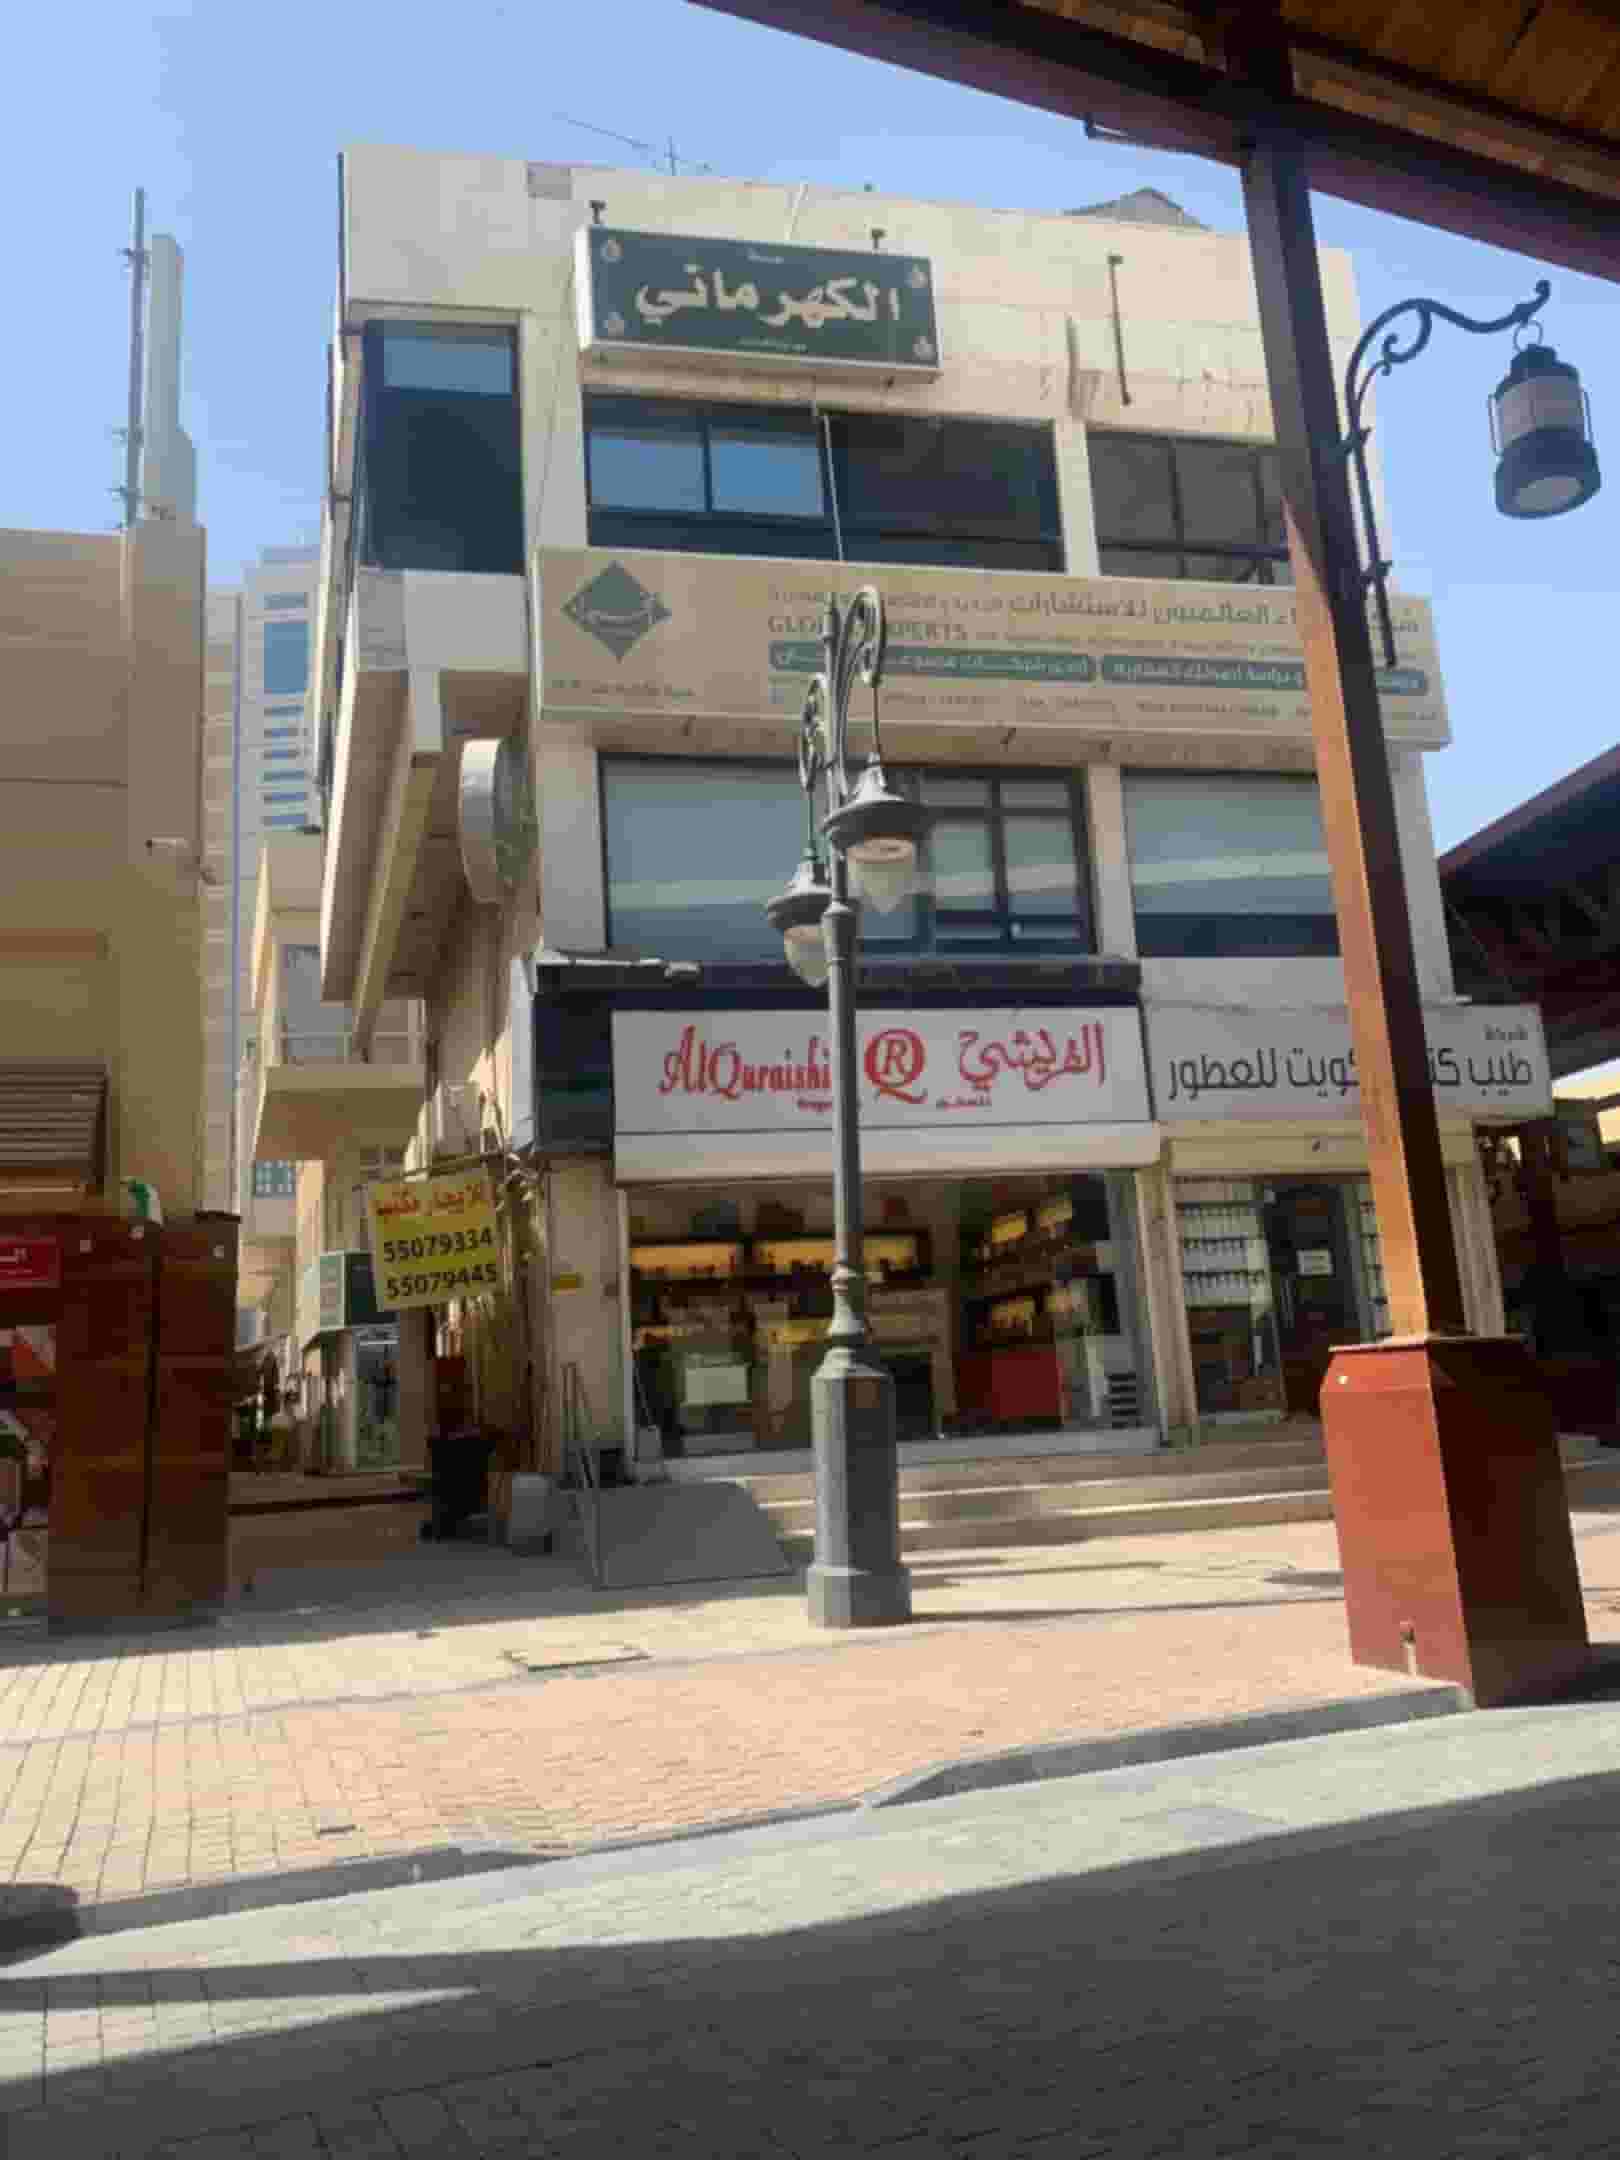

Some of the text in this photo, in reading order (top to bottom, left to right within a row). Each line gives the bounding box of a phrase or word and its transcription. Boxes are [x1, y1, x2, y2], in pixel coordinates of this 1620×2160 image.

[1168, 1047, 1277, 1101] للعطور
[1467, 1049, 1533, 1097] طيب
[383, 1227, 493, 1263] 55079334
[386, 1263, 498, 1298] 55079445
